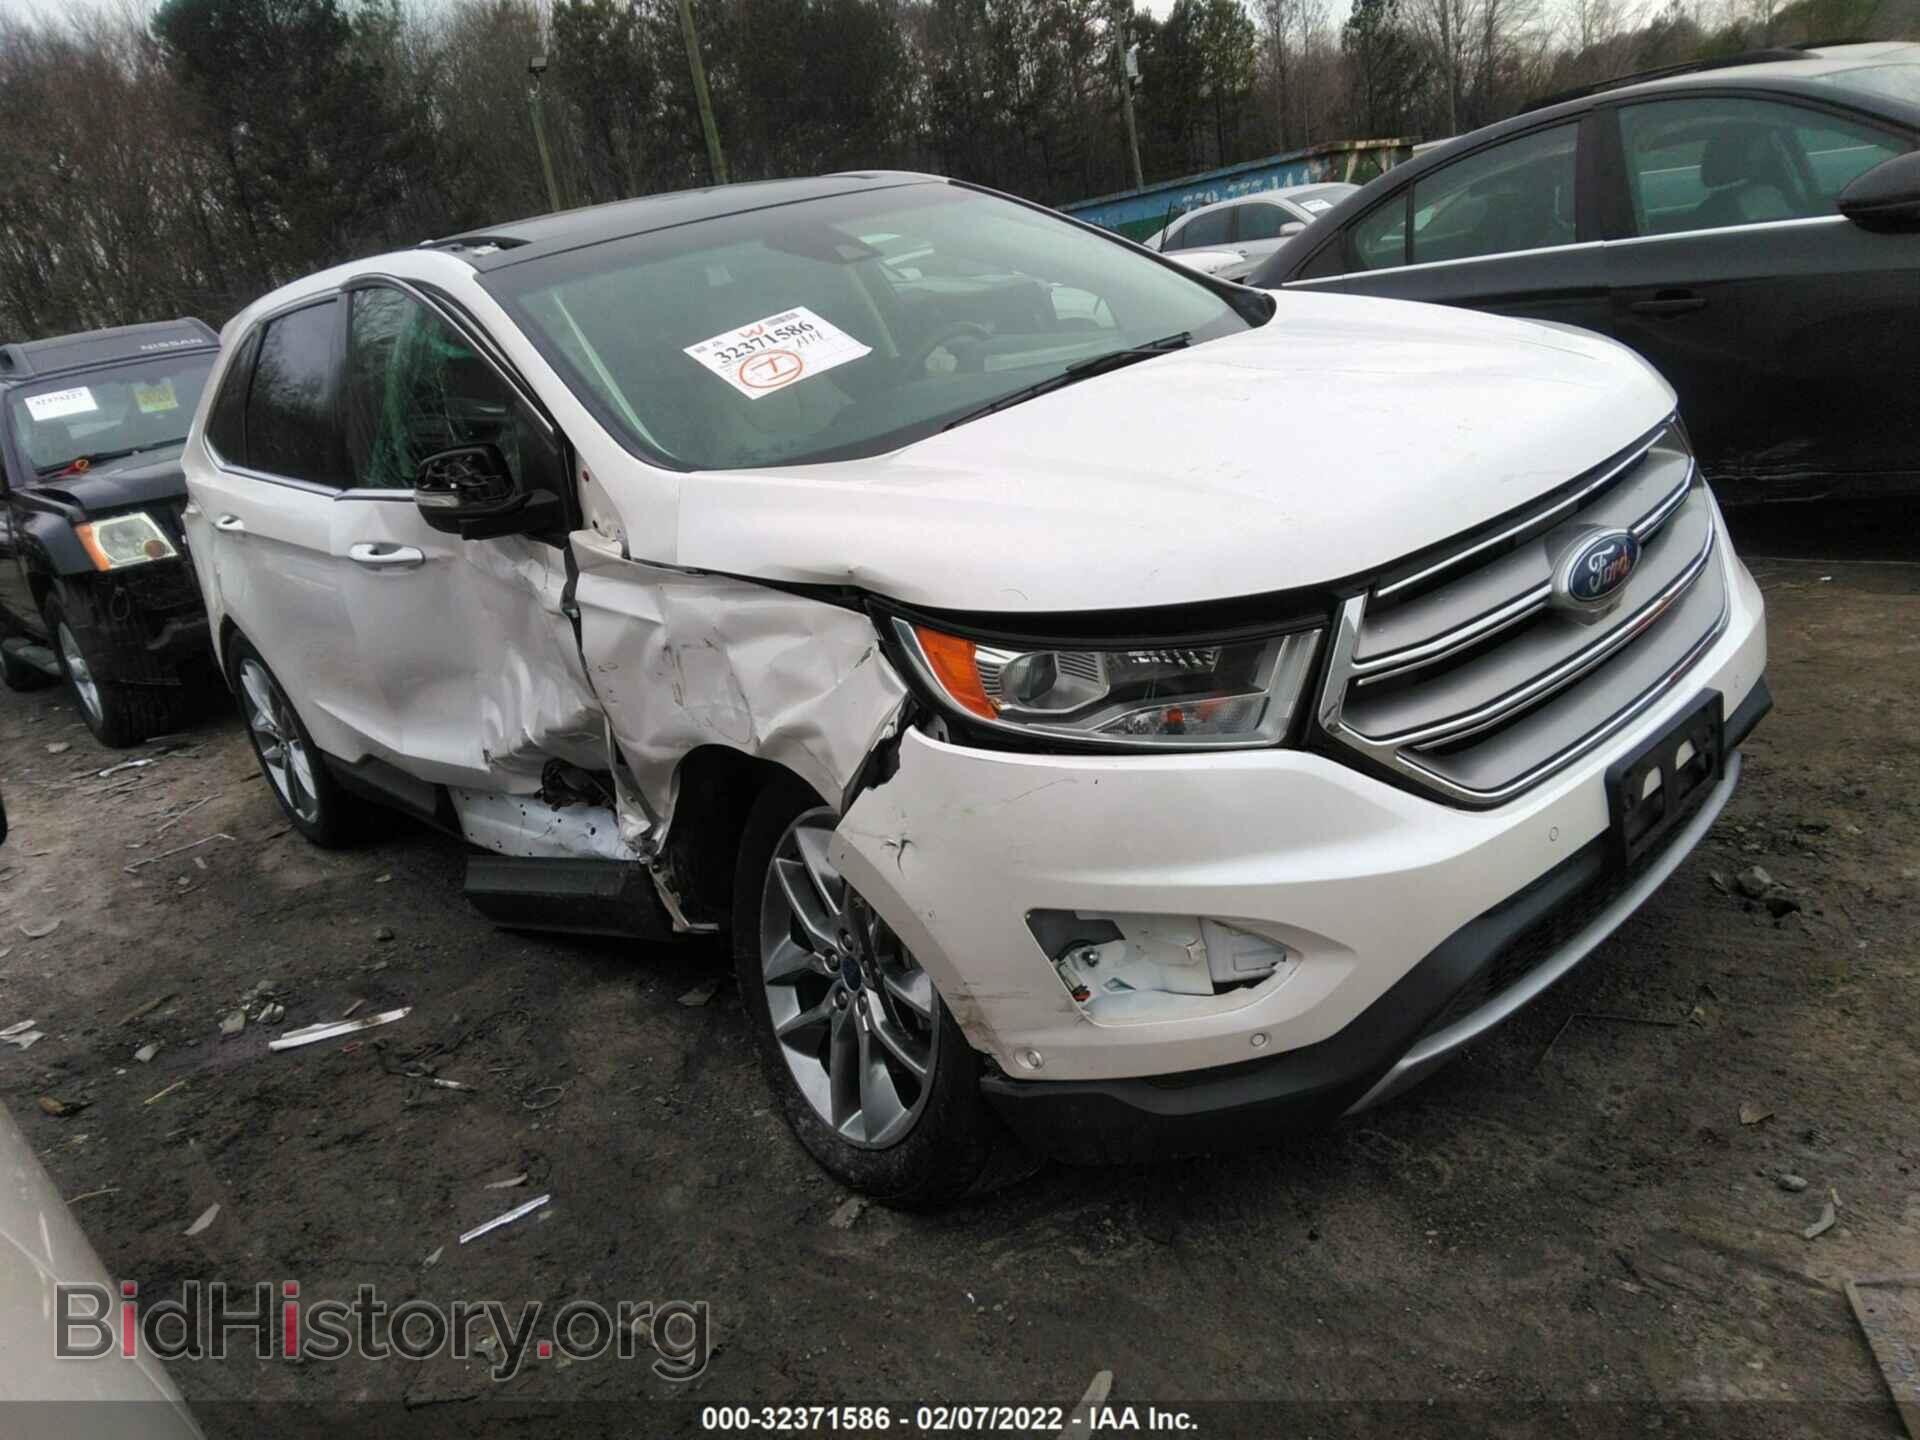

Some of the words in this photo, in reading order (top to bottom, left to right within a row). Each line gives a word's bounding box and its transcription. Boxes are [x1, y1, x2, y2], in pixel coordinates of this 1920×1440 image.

[140, 338, 203, 352] NISSAN
[714, 320, 814, 364] 32371586
[1588, 544, 1632, 593] Ford
